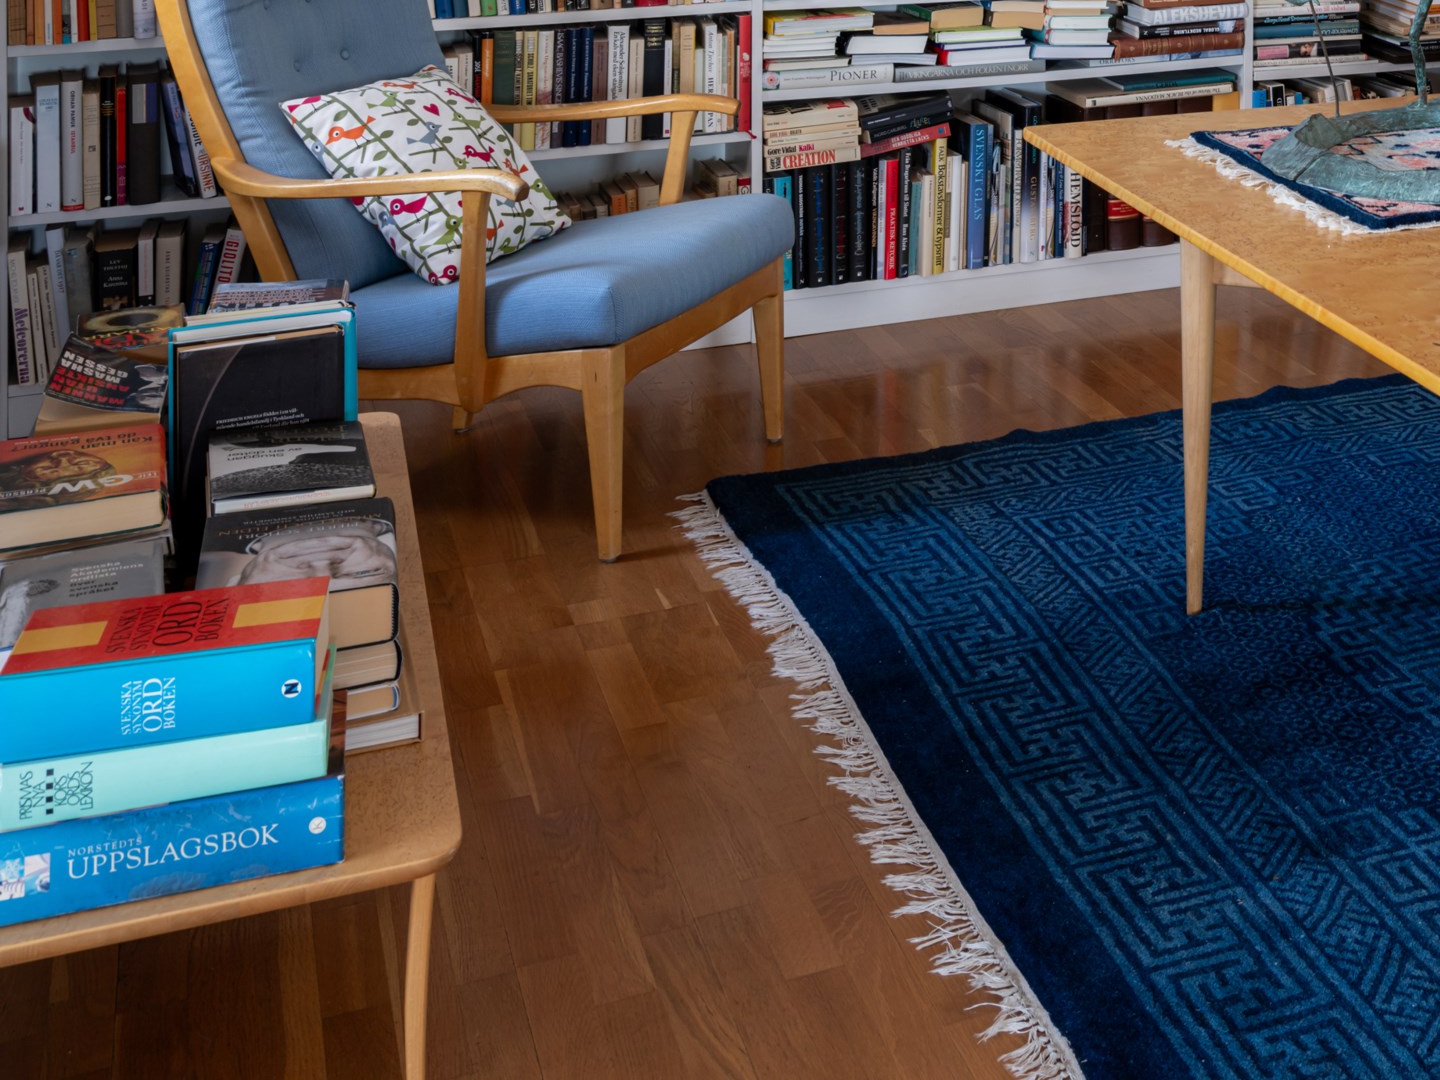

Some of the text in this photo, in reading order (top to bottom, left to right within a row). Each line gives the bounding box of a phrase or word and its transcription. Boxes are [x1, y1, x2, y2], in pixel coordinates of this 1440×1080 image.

[613, 31, 618, 39] En
[555, 53, 564, 85] BASHEVIS
[617, 60, 625, 93] Solsjenitsyn
[830, 70, 878, 81] PIONER
[767, 144, 814, 156] Gore Vidal Kalki
[783, 150, 836, 169] CREATION
[974, 129, 985, 221] SVENSKT GLAS
[936, 164, 945, 227] Bokstavsformer
[1069, 171, 1082, 248] HEMSLÖJD
[937, 227, 943, 235] &
[14, 308, 30, 383] Meteorerna
[56, 366, 130, 392] ANSIKTE
[60, 358, 121, 384] MASHA
[63, 350, 128, 378] GESSEN
[49, 382, 125, 405] MANNEN
[53, 375, 98, 393] UTAN
[81, 436, 153, 450] Kan man
[105, 606, 142, 655] SVENSKA
[130, 604, 163, 653] SYNONYM
[153, 601, 202, 648] ORD
[194, 598, 230, 644] BOKEN
[121, 681, 132, 735] SVENSKA
[132, 680, 142, 734] SYNONYM
[142, 678, 163, 732] ORD
[163, 677, 176, 728] BOKEN
[20, 771, 32, 820] PRISMAS
[33, 782, 45, 808] NYA
[55, 775, 67, 806] KORS
[68, 771, 80, 806] ORDS
[80, 762, 94, 810] LEXIKON
[67, 824, 279, 879] UPPSLAGSBOK
[68, 837, 142, 857] NORSTEDTS
